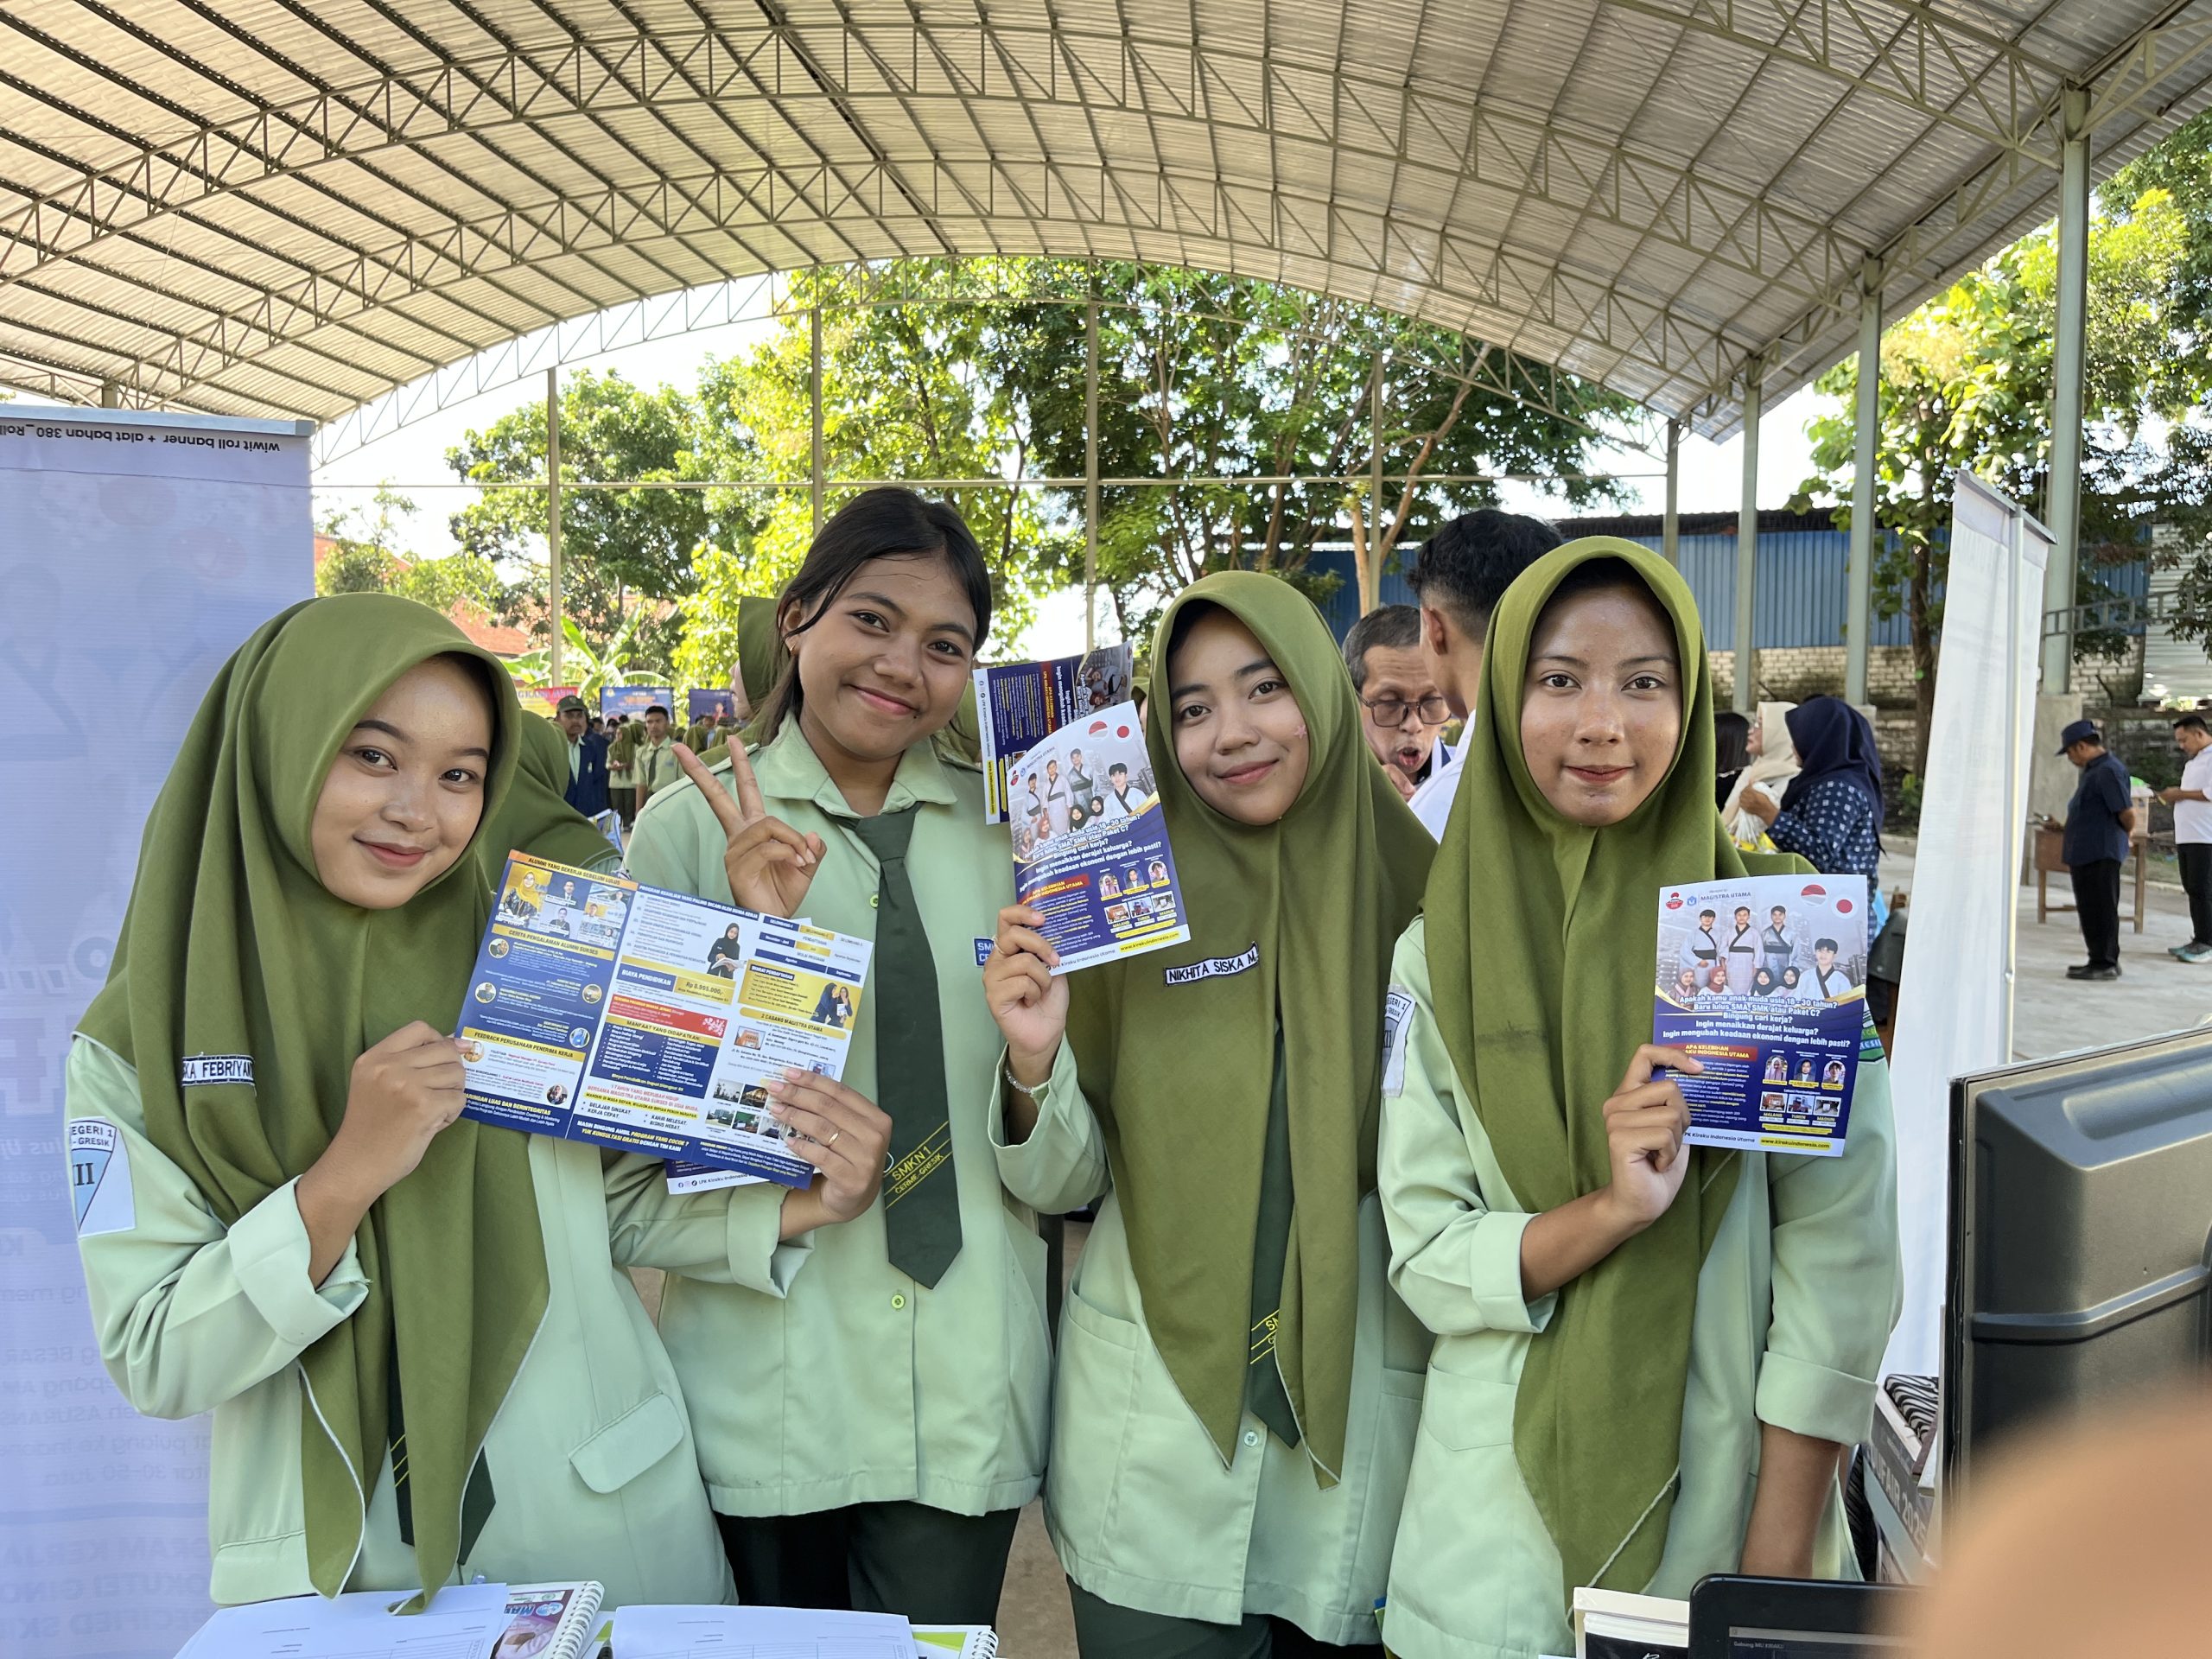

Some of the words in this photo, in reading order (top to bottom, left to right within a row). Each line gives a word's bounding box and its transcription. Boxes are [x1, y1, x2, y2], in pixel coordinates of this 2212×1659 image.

[66, 427, 113, 442] bahan
[117, 432, 143, 442] alat
[163, 434, 214, 449] banner
[218, 439, 240, 450] roll
[243, 441, 280, 452] wiwit
[1119, 813, 1141, 824] tahun?
[1073, 836, 1087, 844] SMK
[1102, 827, 1120, 836] Paket
[1089, 837, 1109, 849] kerja?
[528, 857, 547, 867] ALUMNI
[978, 943, 993, 951] SM
[1169, 963, 1210, 982] NIKHITA
[1214, 958, 1243, 973] SISKA
[621, 969, 638, 978] BIAYA
[638, 972, 671, 986] PENDIDIKAN
[1387, 996, 1401, 1008] EGERI
[1679, 995, 1705, 1004] Apakah
[1812, 1000, 1838, 1009] tahun?
[1694, 1002, 1710, 1011] Baru
[1712, 1002, 1729, 1011] lulus
[1731, 1003, 1750, 1013] SMA,
[1751, 1004, 1768, 1013] SMK
[1723, 1012, 1752, 1021] Bingung
[1769, 1015, 1793, 1024] kerja?
[1695, 1020, 1713, 1028] Ingin
[1715, 1020, 1755, 1030] menaikkan
[1756, 1023, 1782, 1033] derajat
[1783, 1026, 1818, 1036] keluarga?
[1662, 1029, 1680, 1039] Ingin
[1681, 1027, 1718, 1039] mengubah
[1719, 1029, 1751, 1039] keadaan
[1751, 1032, 1782, 1040] ekonomi
[1783, 1034, 1808, 1045] dengan
[1809, 1037, 1827, 1046] lebih
[1827, 1039, 1850, 1048] pasti?
[1860, 1039, 1881, 1050] RESI
[72, 1126, 103, 1135] EGERI
[79, 1138, 110, 1147] GRESIK
[892, 1151, 925, 1180] SMKN
[924, 1146, 931, 1154] 1
[919, 1154, 944, 1174] GRESIK
